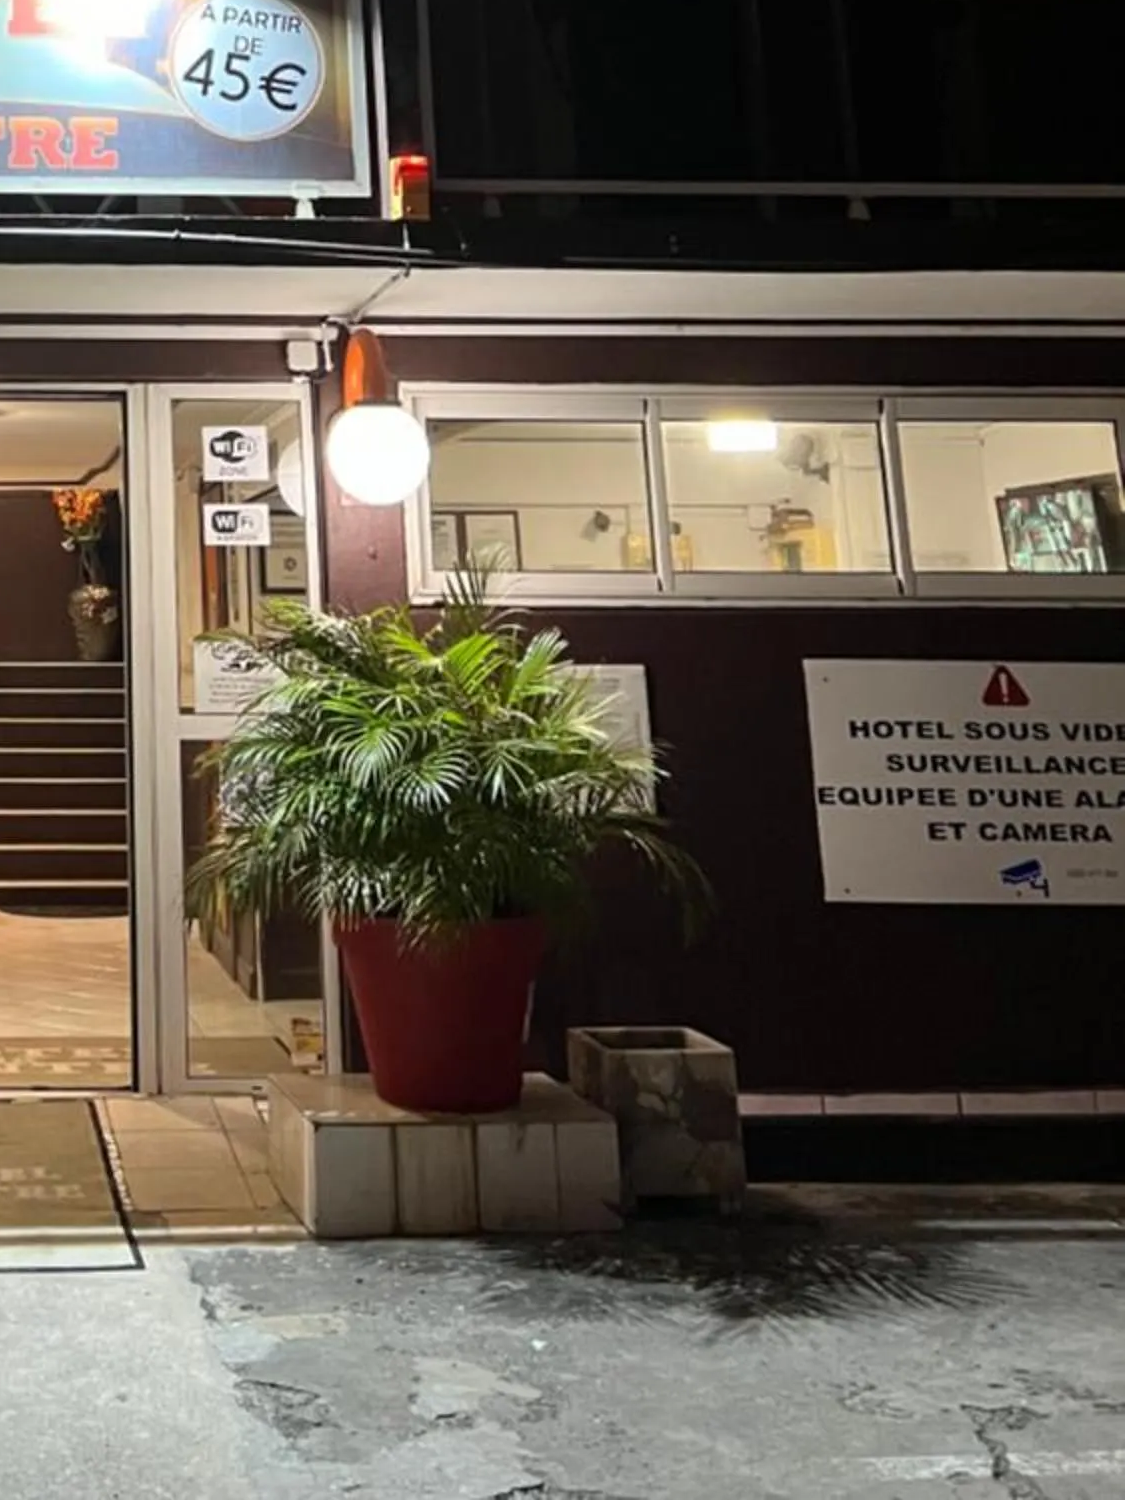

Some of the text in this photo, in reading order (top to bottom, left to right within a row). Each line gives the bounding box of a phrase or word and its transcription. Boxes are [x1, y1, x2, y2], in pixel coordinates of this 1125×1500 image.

[222, 5, 303, 34] PARTIR
[234, 35, 264, 56] DE
[183, 47, 307, 112] 45€
[849, 720, 955, 740] HOTEL
[963, 721, 1051, 741] SOUS
[886, 754, 1125, 775] SURVEILLANCE
[817, 787, 958, 807] EQUIPEE
[967, 788, 1064, 809] D'UNE
[927, 822, 1114, 843] ET CAMERA
